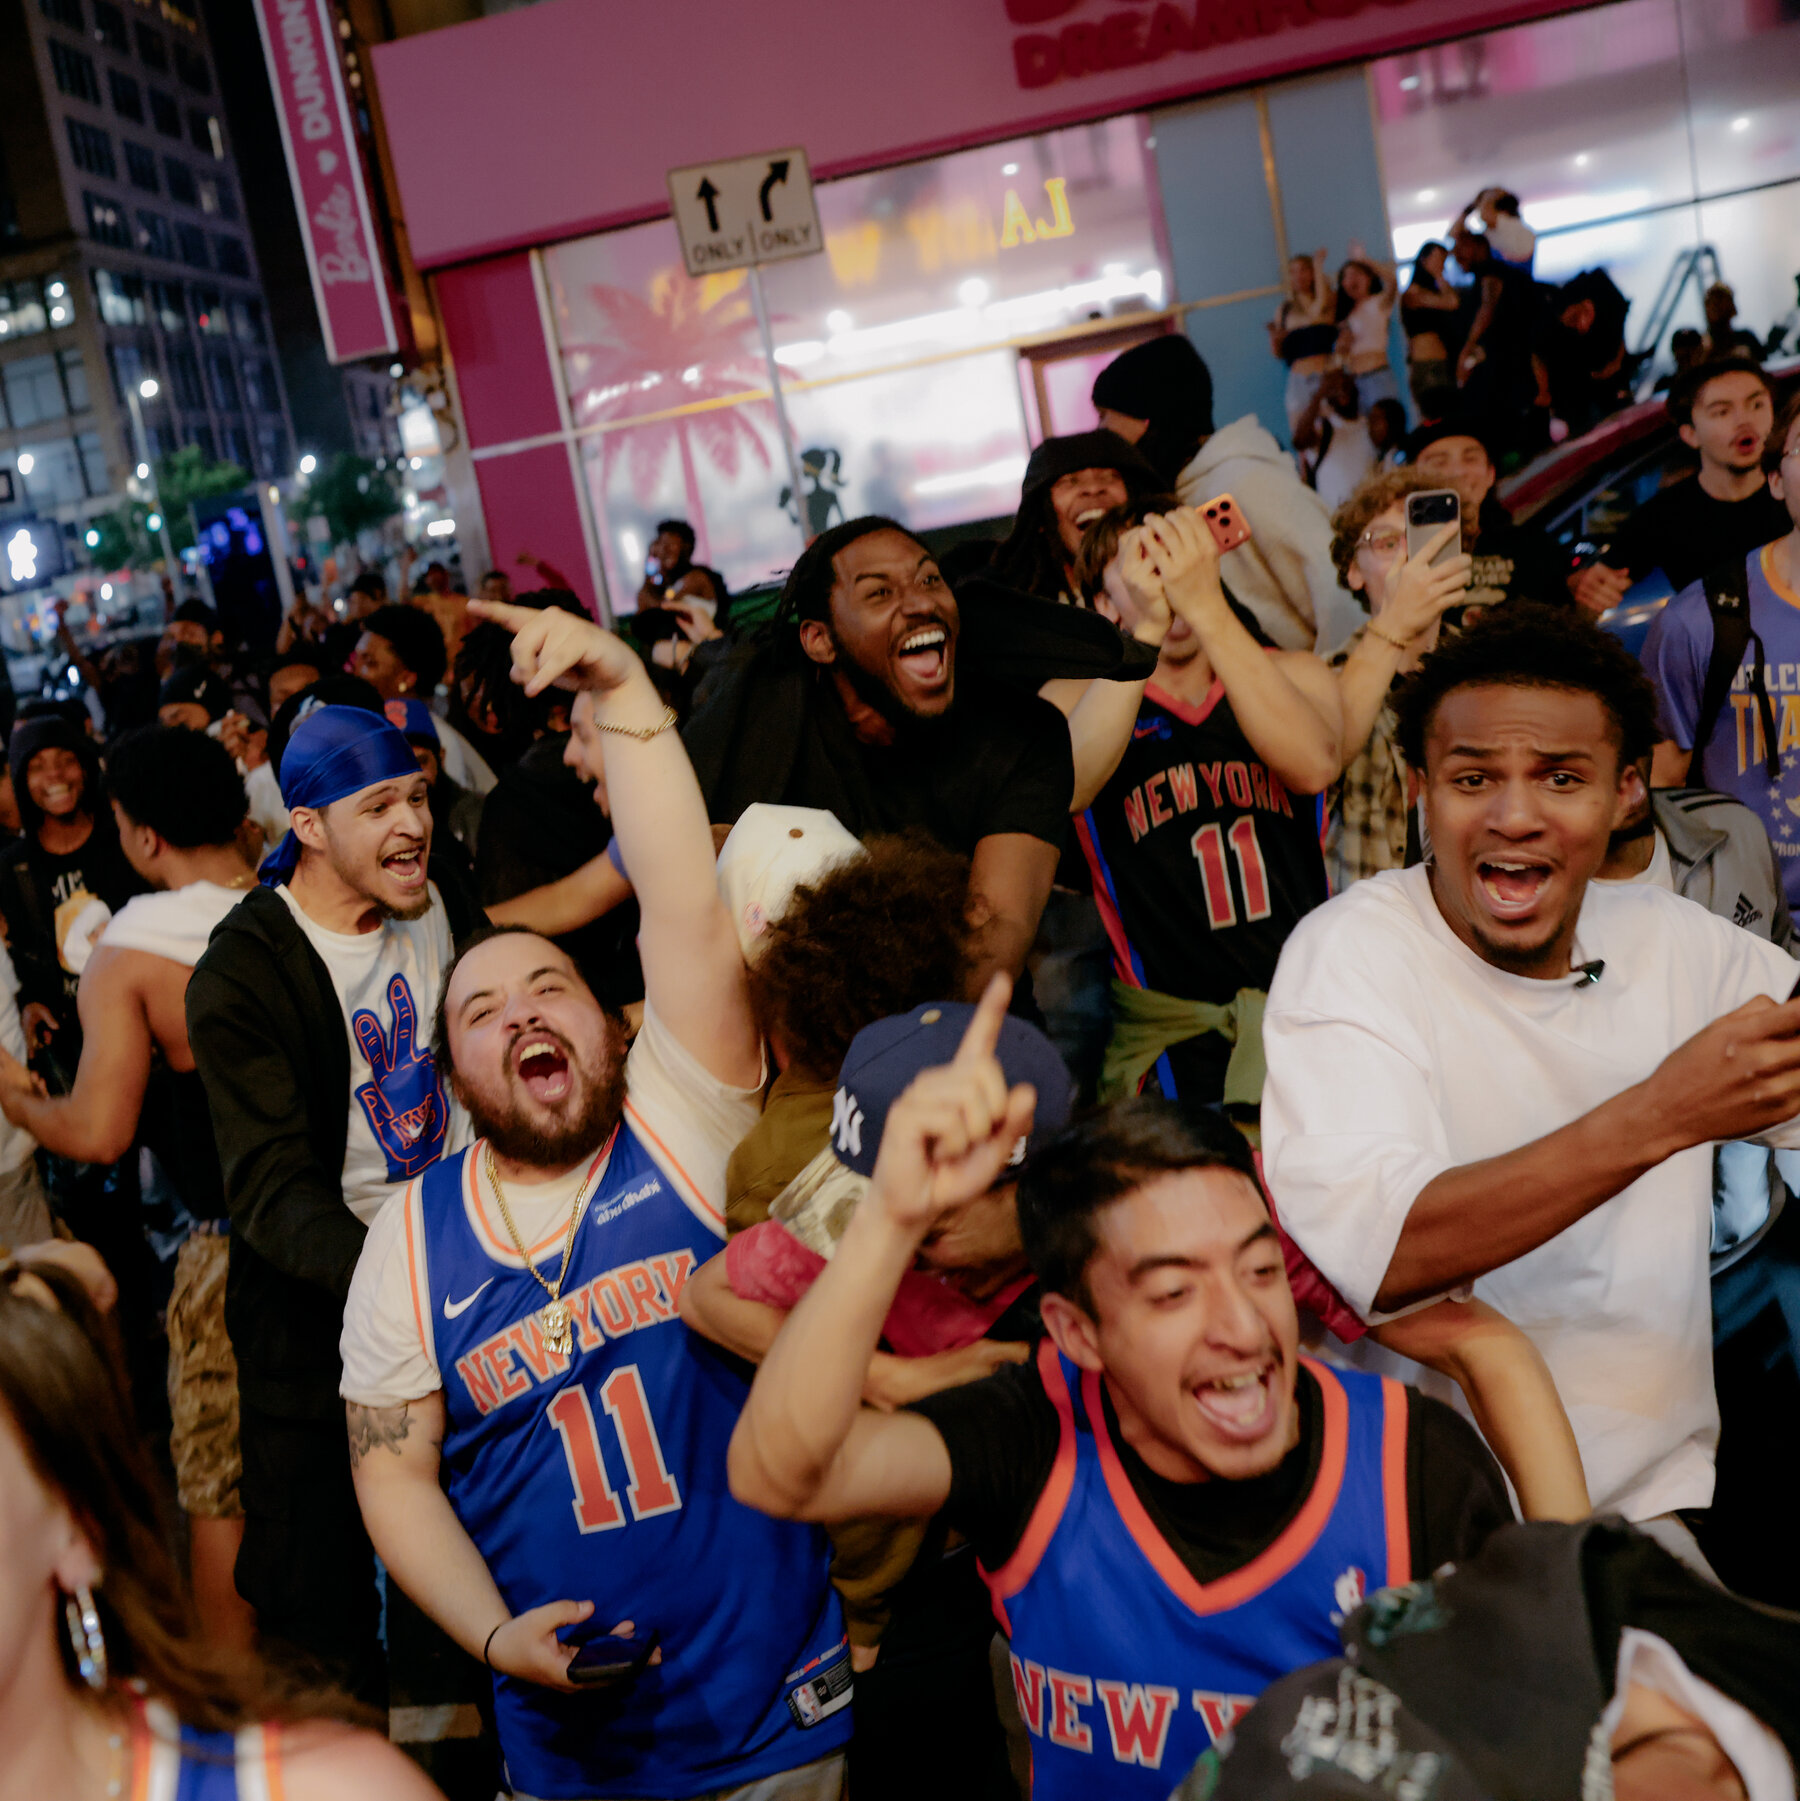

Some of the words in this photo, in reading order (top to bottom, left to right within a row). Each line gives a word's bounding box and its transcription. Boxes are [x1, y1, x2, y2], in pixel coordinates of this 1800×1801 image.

[316, 183, 369, 285] Barbie
[693, 236, 743, 265] ONLY
[761, 226, 811, 252] ONLY
[1124, 762, 1198, 843] NEW
[1198, 761, 1293, 818] YORK
[1191, 814, 1271, 930] 11
[455, 1309, 571, 1416] NEW
[563, 1247, 697, 1354] YORK
[546, 1363, 682, 1535] 11
[1010, 1650, 1179, 1770] NEW
